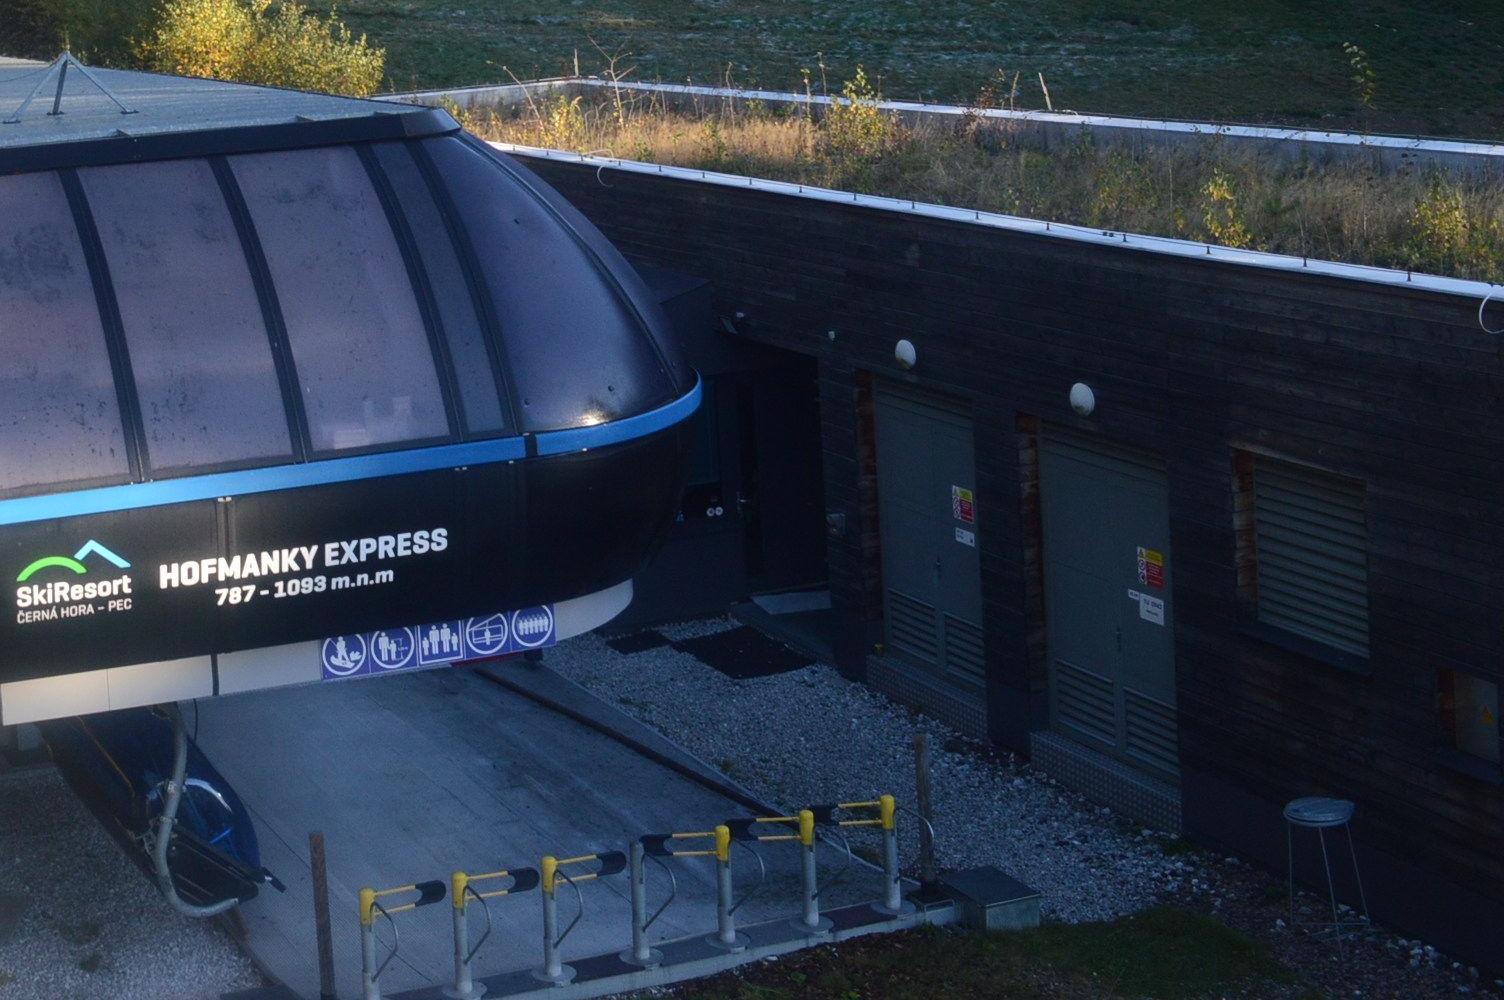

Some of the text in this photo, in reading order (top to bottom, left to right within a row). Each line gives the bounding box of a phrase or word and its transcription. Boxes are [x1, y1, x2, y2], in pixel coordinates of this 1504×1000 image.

[158, 528, 448, 589] HOFMANKY EXPRESS
[16, 574, 132, 608] SkiResort
[214, 584, 256, 606] 787
[274, 576, 327, 598] 1093
[331, 569, 394, 591] m.n.m
[16, 605, 58, 624] ČERNÁ
[60, 603, 95, 618] HORA
[108, 598, 133, 612] PEC
